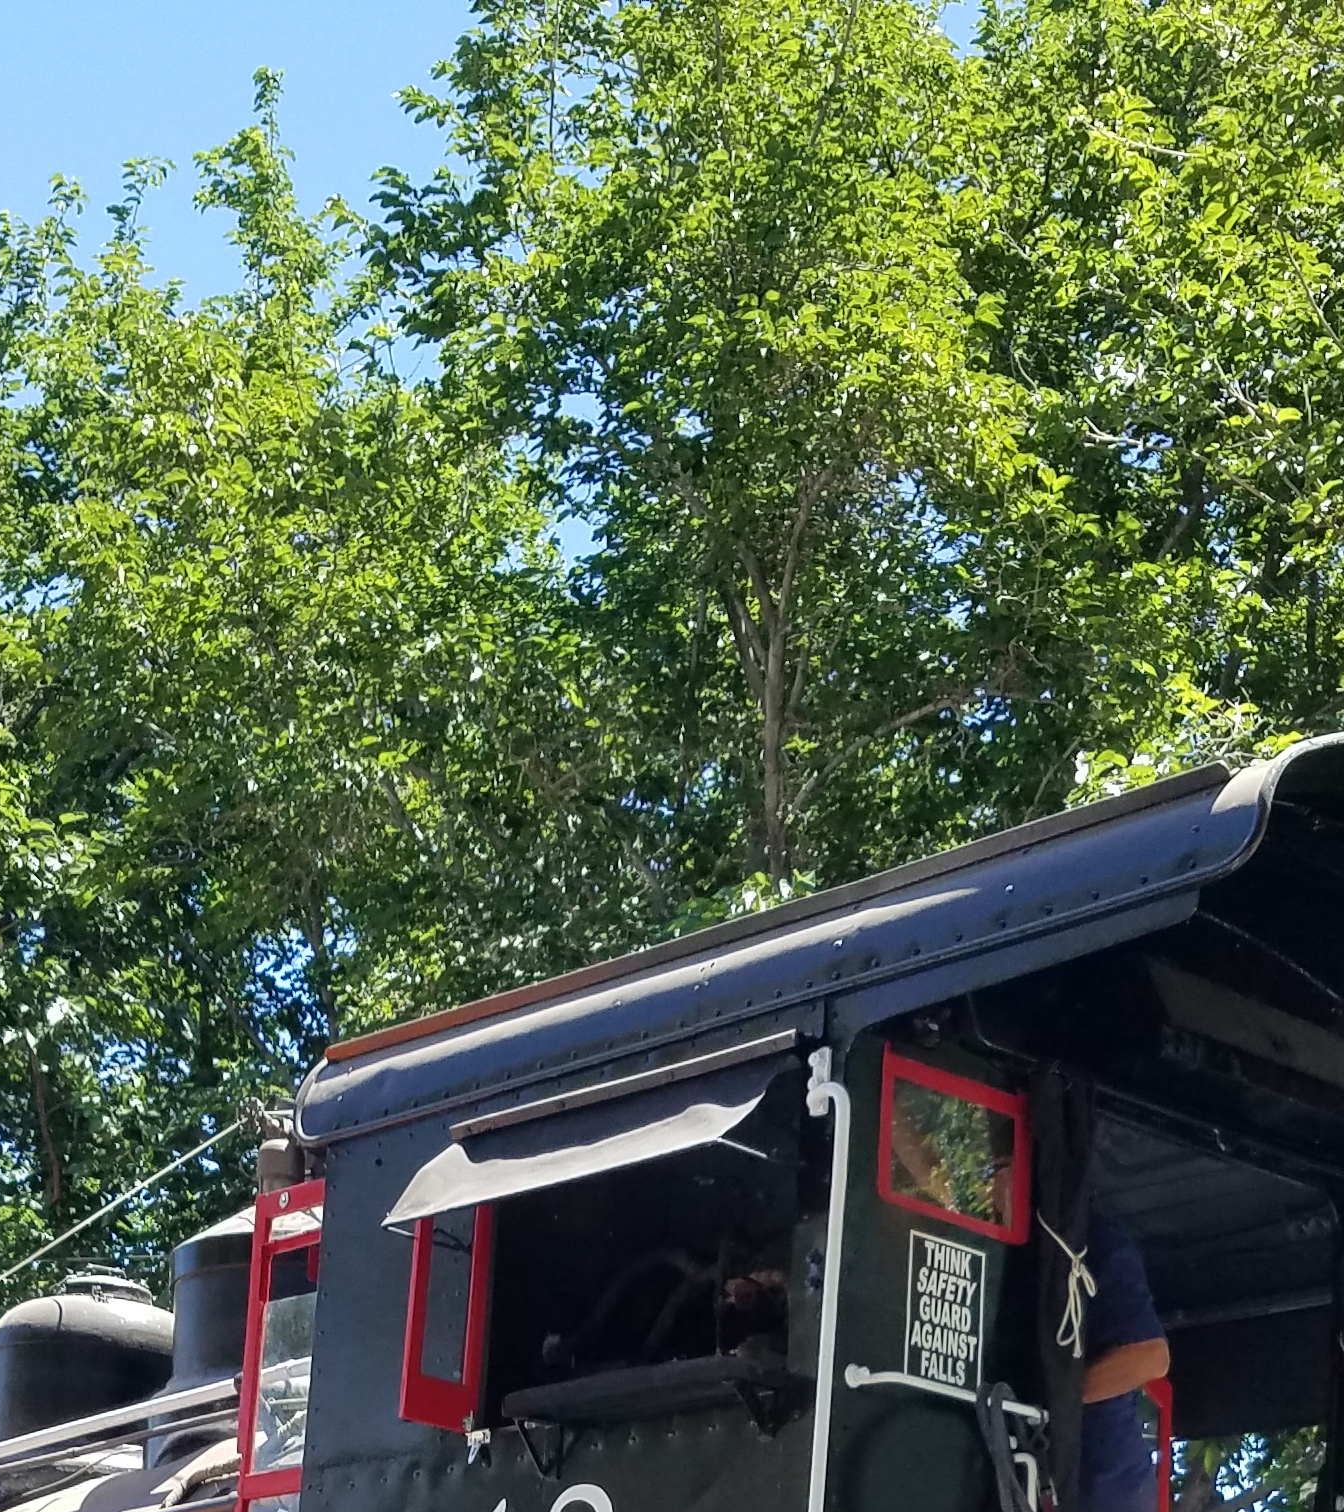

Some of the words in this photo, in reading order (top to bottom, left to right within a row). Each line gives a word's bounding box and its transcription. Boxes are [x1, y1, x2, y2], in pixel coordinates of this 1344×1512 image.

[924, 1240, 972, 1279] THINK
[916, 1266, 978, 1306] SAFETY
[919, 1294, 972, 1332] GUARD
[910, 1320, 978, 1362] AGAINST
[920, 1349, 966, 1386] FALLS
